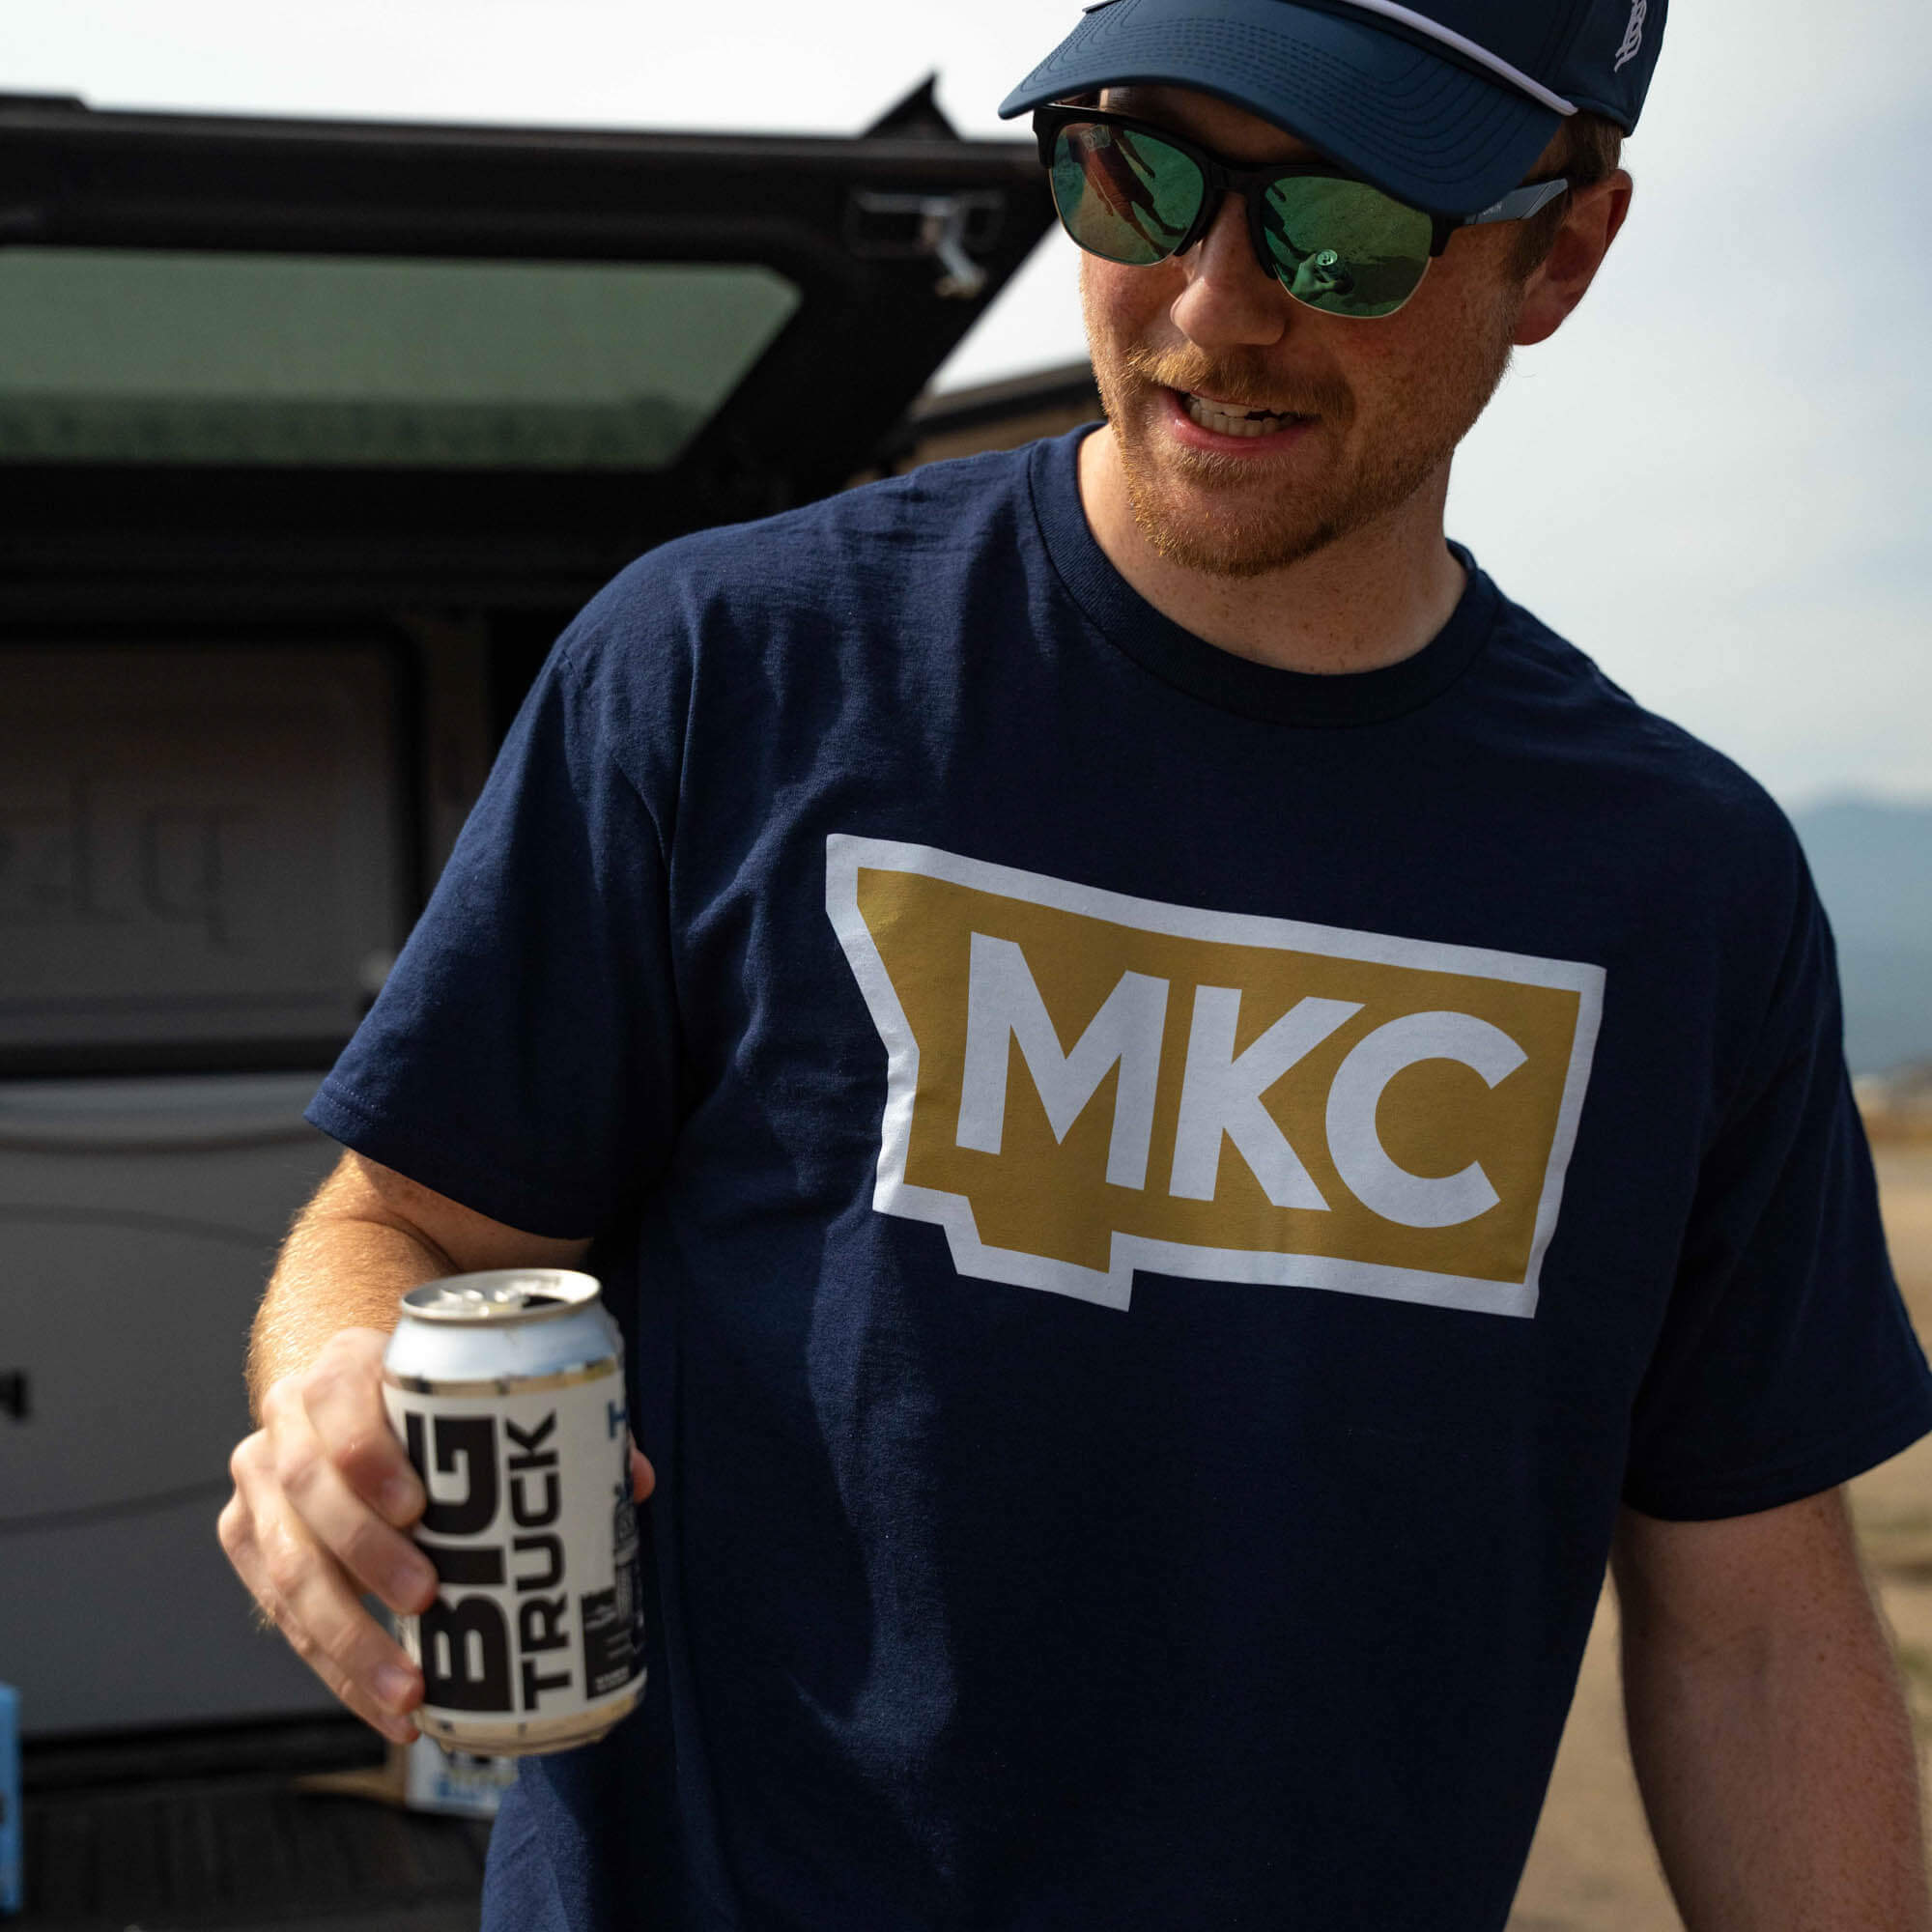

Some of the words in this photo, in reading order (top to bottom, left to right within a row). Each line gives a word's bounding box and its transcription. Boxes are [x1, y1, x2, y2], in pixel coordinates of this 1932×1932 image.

[955, 931, 1529, 1228] MKC
[405, 1410, 514, 1713] BIG
[505, 1409, 573, 1712] TRUCK
